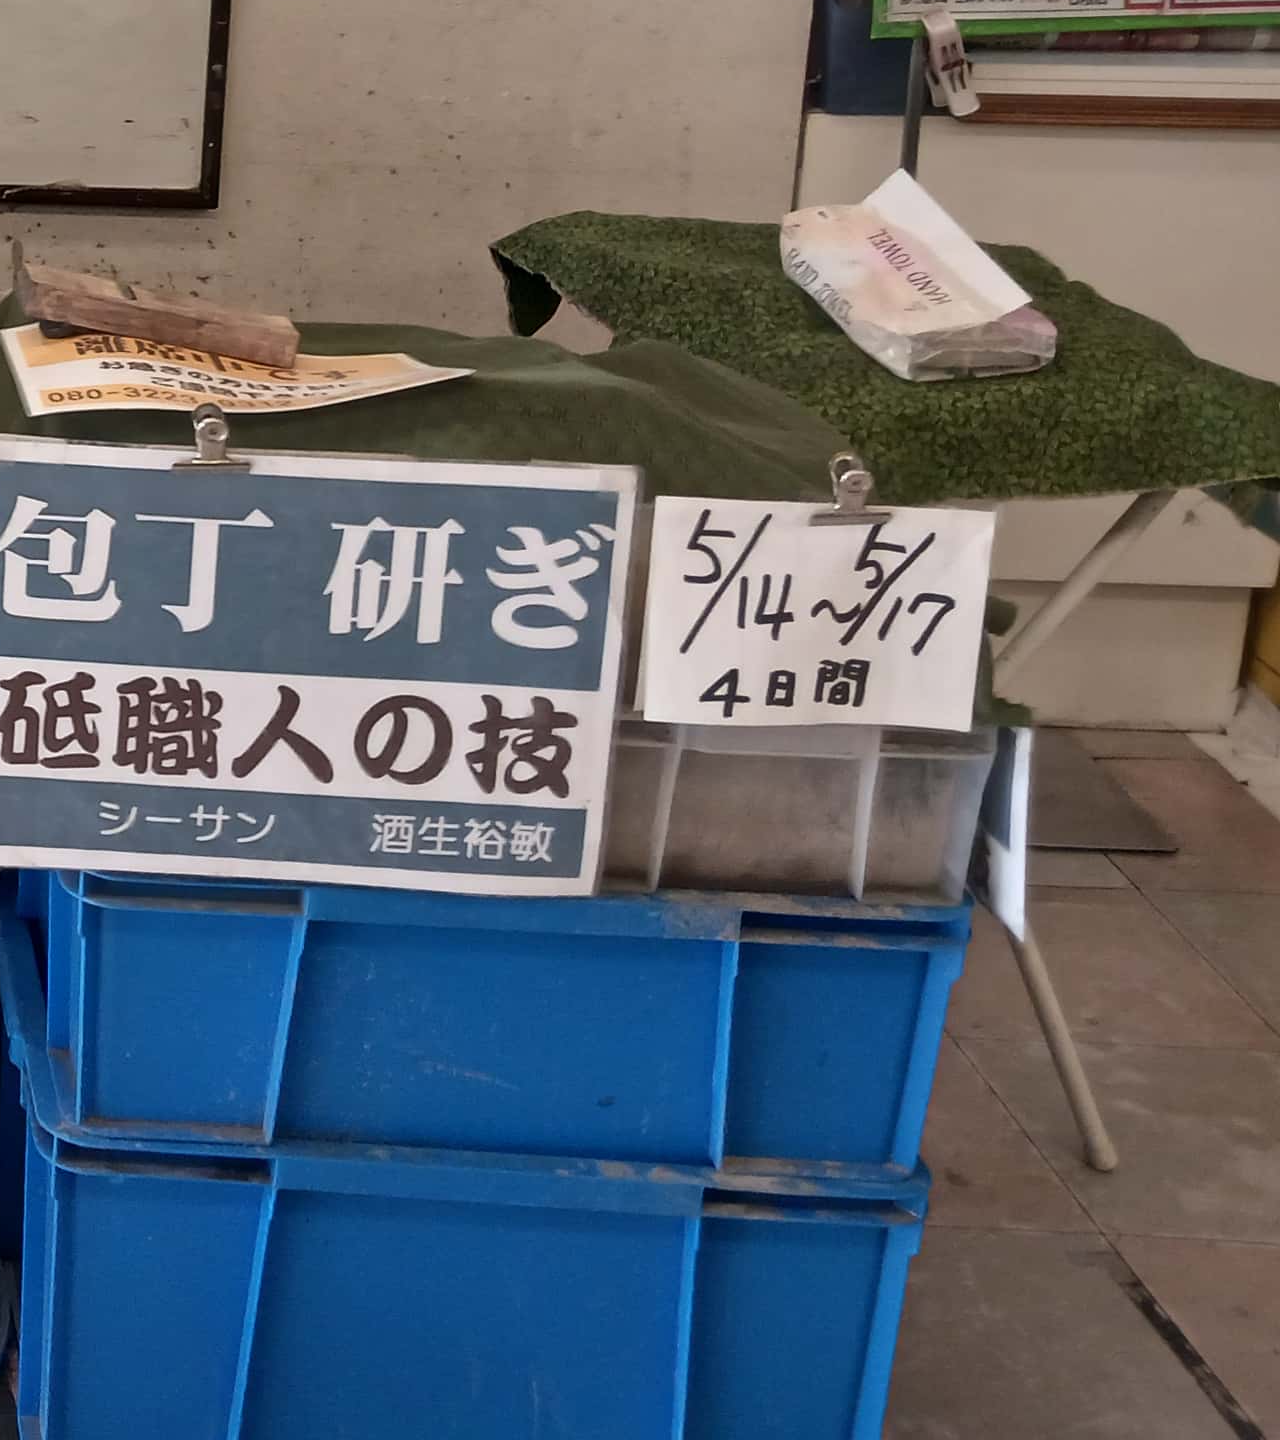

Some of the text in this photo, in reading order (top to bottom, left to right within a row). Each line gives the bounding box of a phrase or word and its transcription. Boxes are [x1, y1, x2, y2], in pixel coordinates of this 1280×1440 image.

[866, 227, 953, 305] HAND TOWEL
[322, 516, 617, 650] 研ぎ
[699, 659, 871, 718] 4日間
[96, 800, 556, 864] シーサン 酒生裕敏
